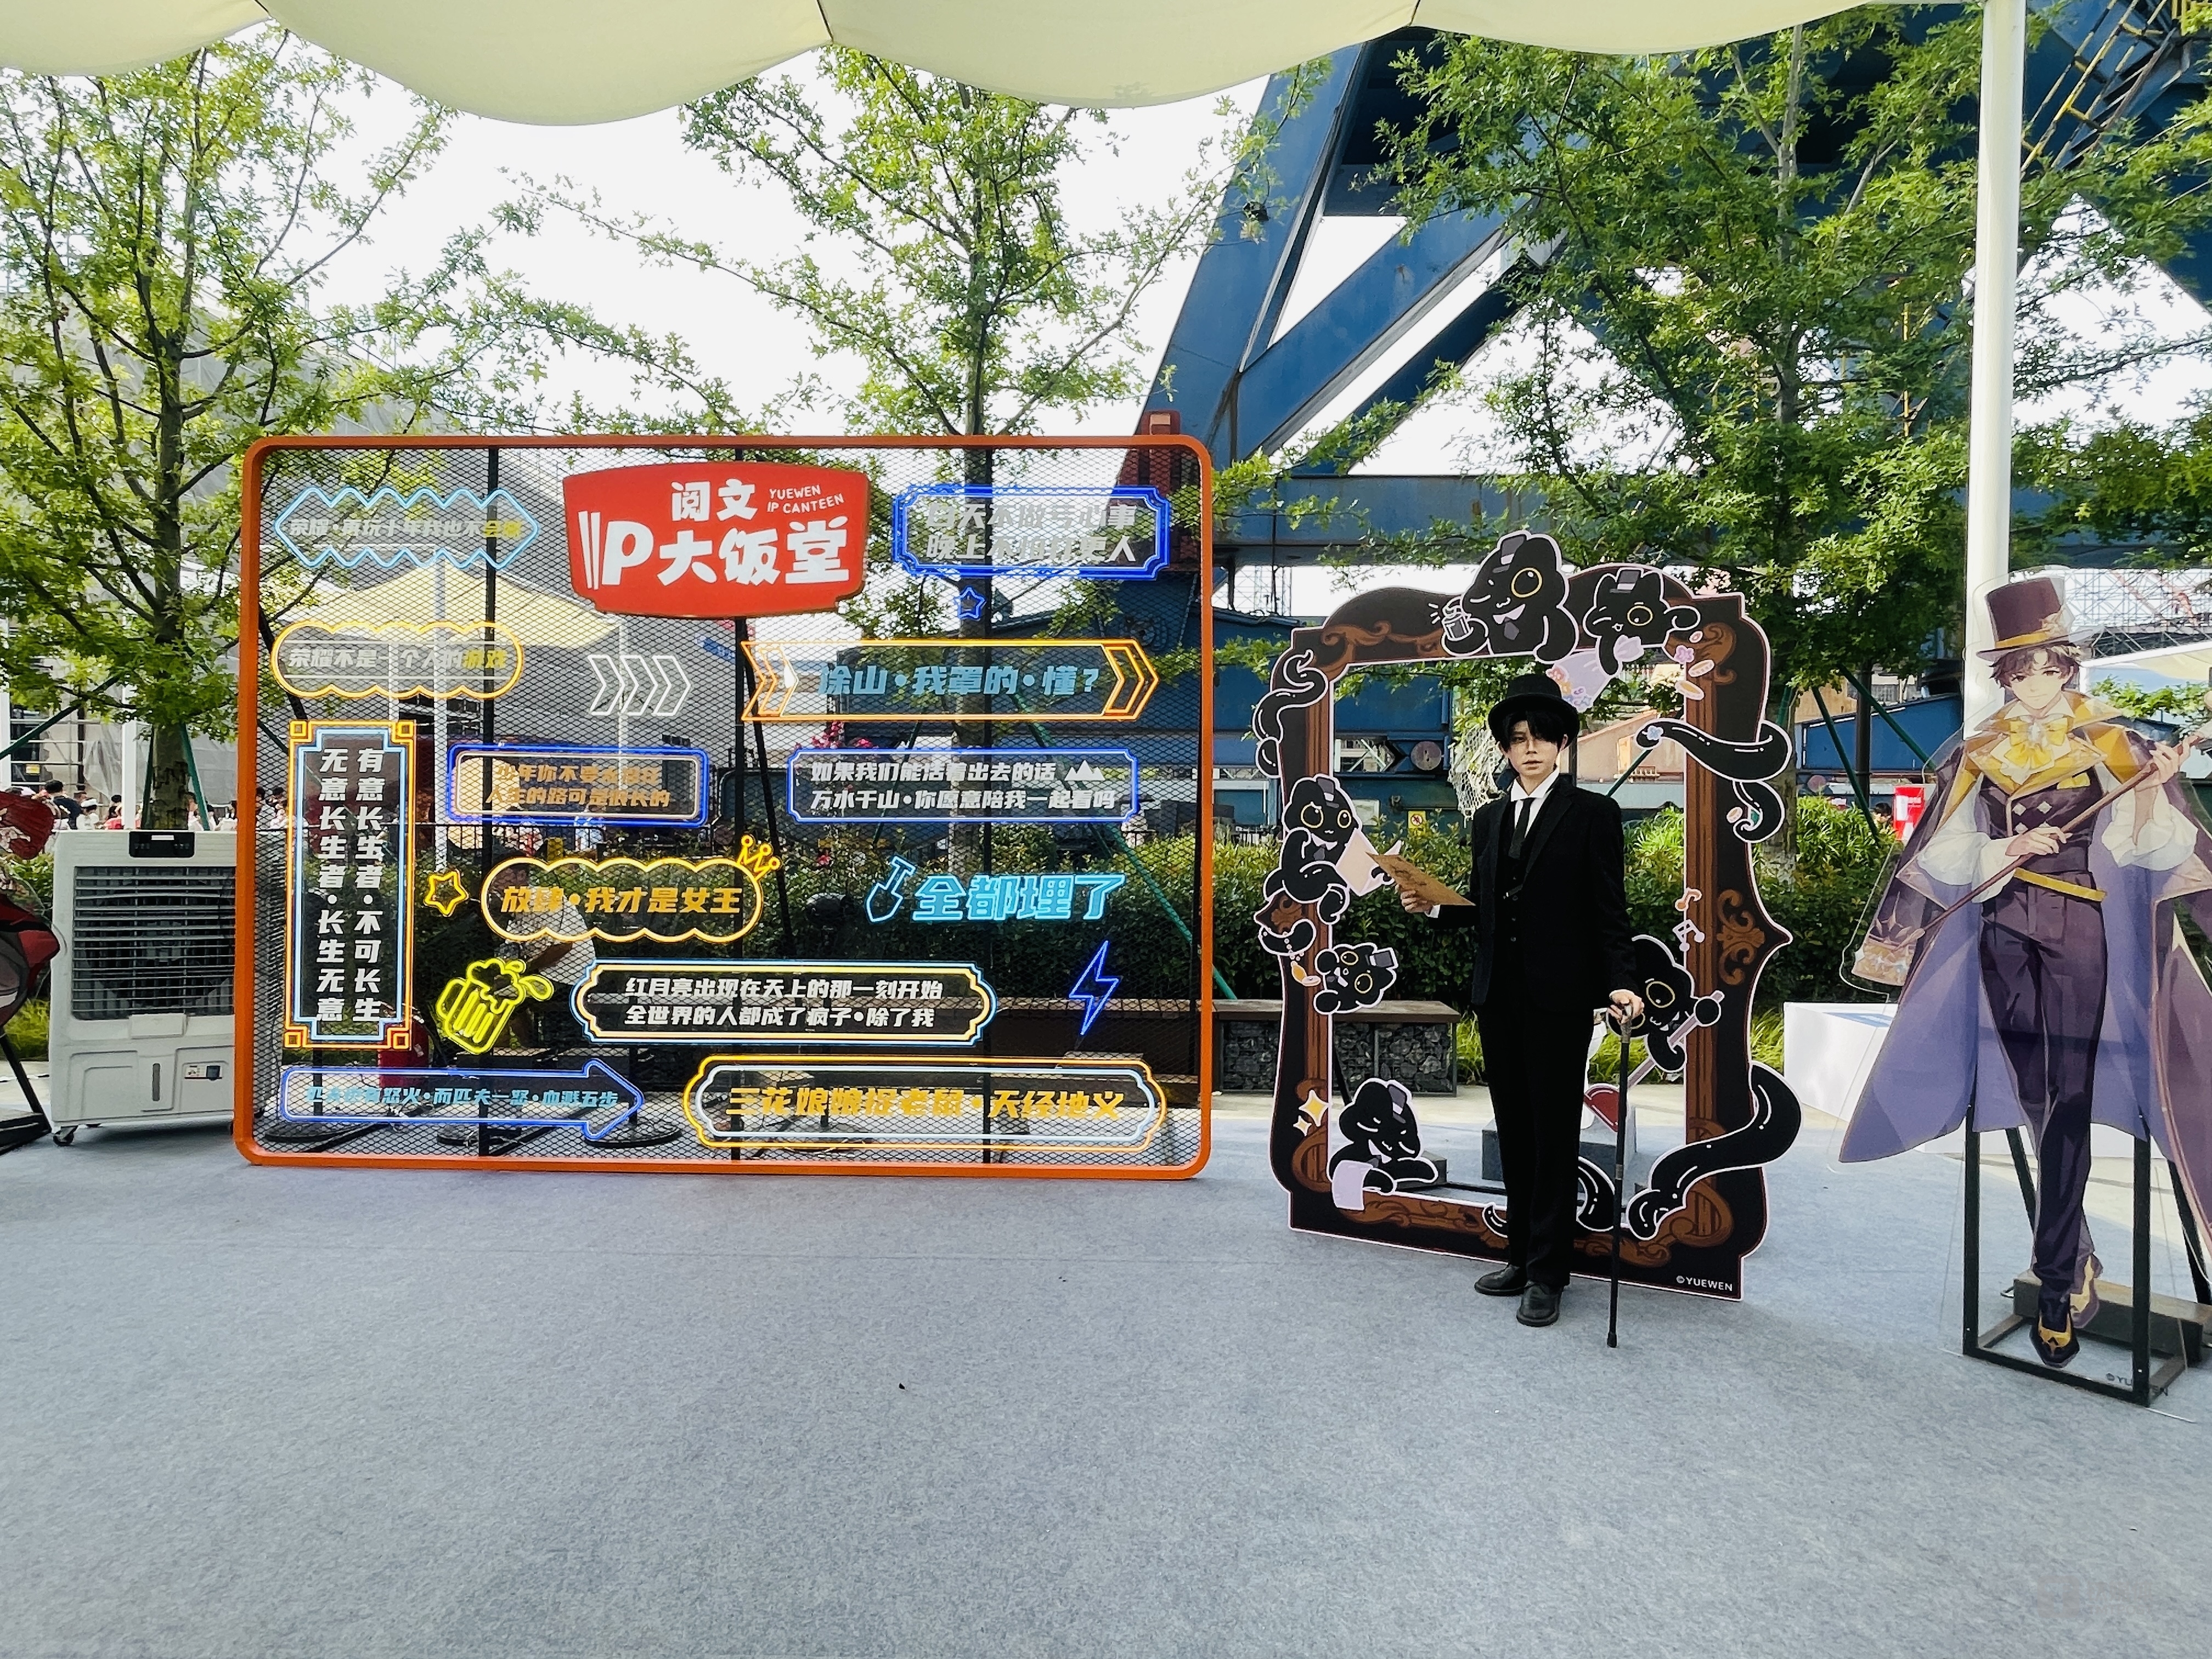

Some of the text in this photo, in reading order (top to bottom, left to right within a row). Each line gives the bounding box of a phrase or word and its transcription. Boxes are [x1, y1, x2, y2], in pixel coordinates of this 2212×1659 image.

[671, 478, 759, 522] 阅文
[769, 484, 821, 500] YUEWEN
[767, 493, 845, 514] IP CANTEEN
[927, 503, 1137, 529] 白天不做亏心事
[926, 534, 1137, 562] 晚上不怕打更人
[810, 761, 1057, 782] 如果我们能活着出去的话
[485, 787, 671, 807] 人生的路可是很长的
[912, 873, 1126, 921] 全都埋了
[624, 978, 944, 1000] 红月亮出现在天上的那一刻开始
